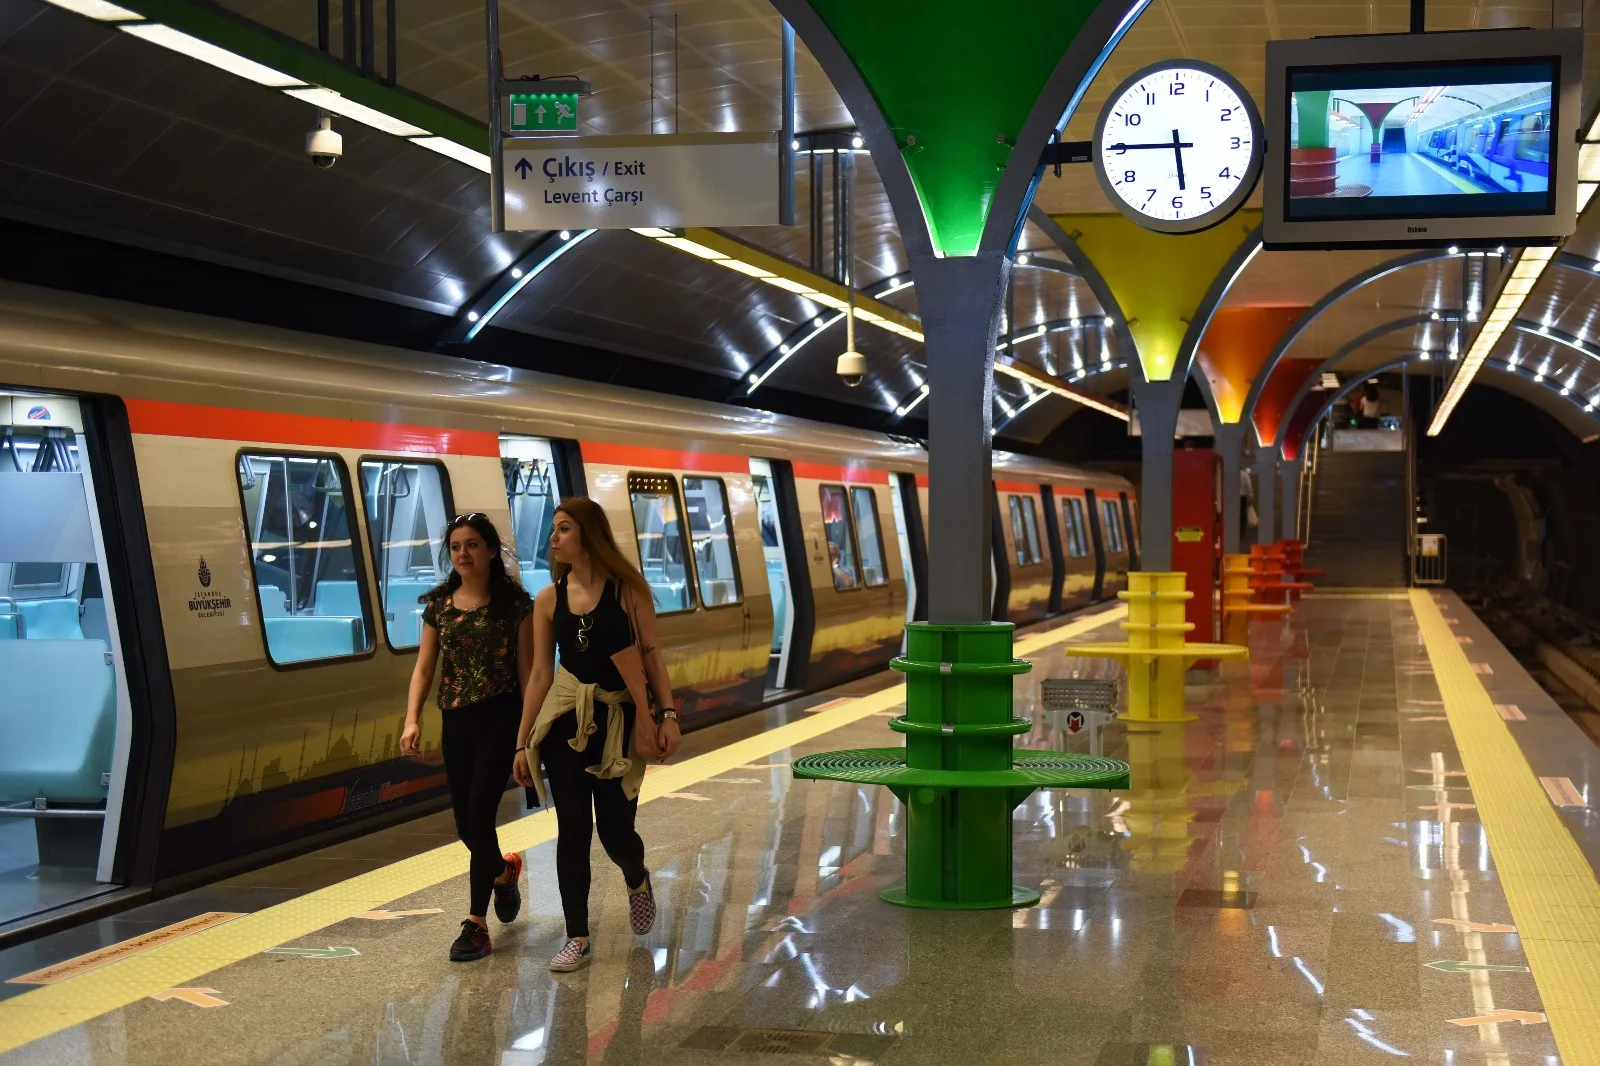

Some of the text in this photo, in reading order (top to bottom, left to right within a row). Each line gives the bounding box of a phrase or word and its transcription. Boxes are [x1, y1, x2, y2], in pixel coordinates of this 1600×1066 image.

[1169, 82, 1185, 96] 12
[1206, 89, 1209, 102] 1
[1146, 92, 1155, 105] 11
[1125, 113, 1141, 126] 10
[1220, 108, 1232, 121] 2
[1230, 136, 1241, 149] 3
[542, 156, 596, 184] Çıkış
[614, 160, 646, 176] Exit
[1124, 170, 1136, 182] 8
[1218, 166, 1231, 179] 4
[544, 188, 643, 207] Levent Çarşı
[1146, 188, 1157, 201] 7
[1200, 186, 1211, 199] 5
[1171, 196, 1183, 209] 6
